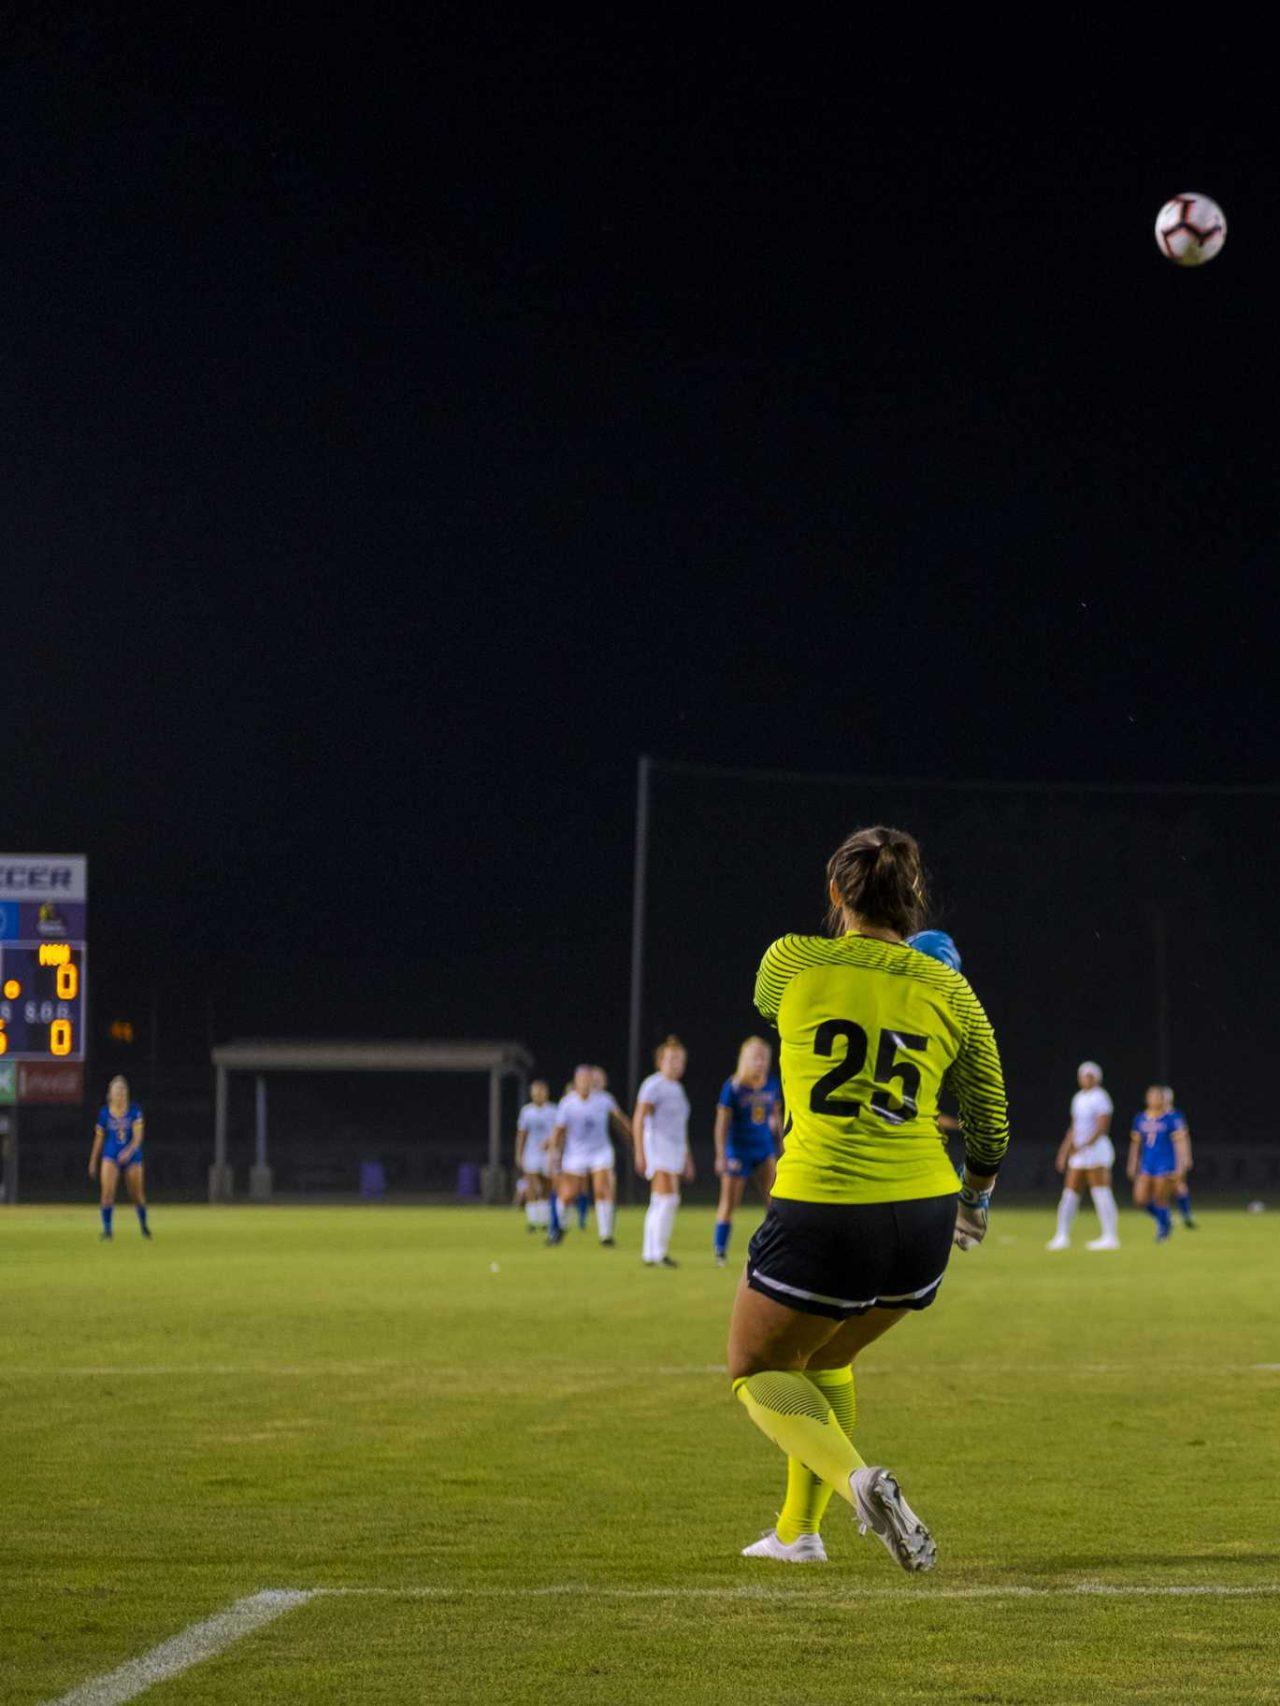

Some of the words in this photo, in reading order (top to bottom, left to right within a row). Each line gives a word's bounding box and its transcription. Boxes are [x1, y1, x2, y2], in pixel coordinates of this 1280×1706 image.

[57, 964, 78, 999] 0
[50, 1019, 72, 1056] 0
[810, 1018, 928, 1125] 25
